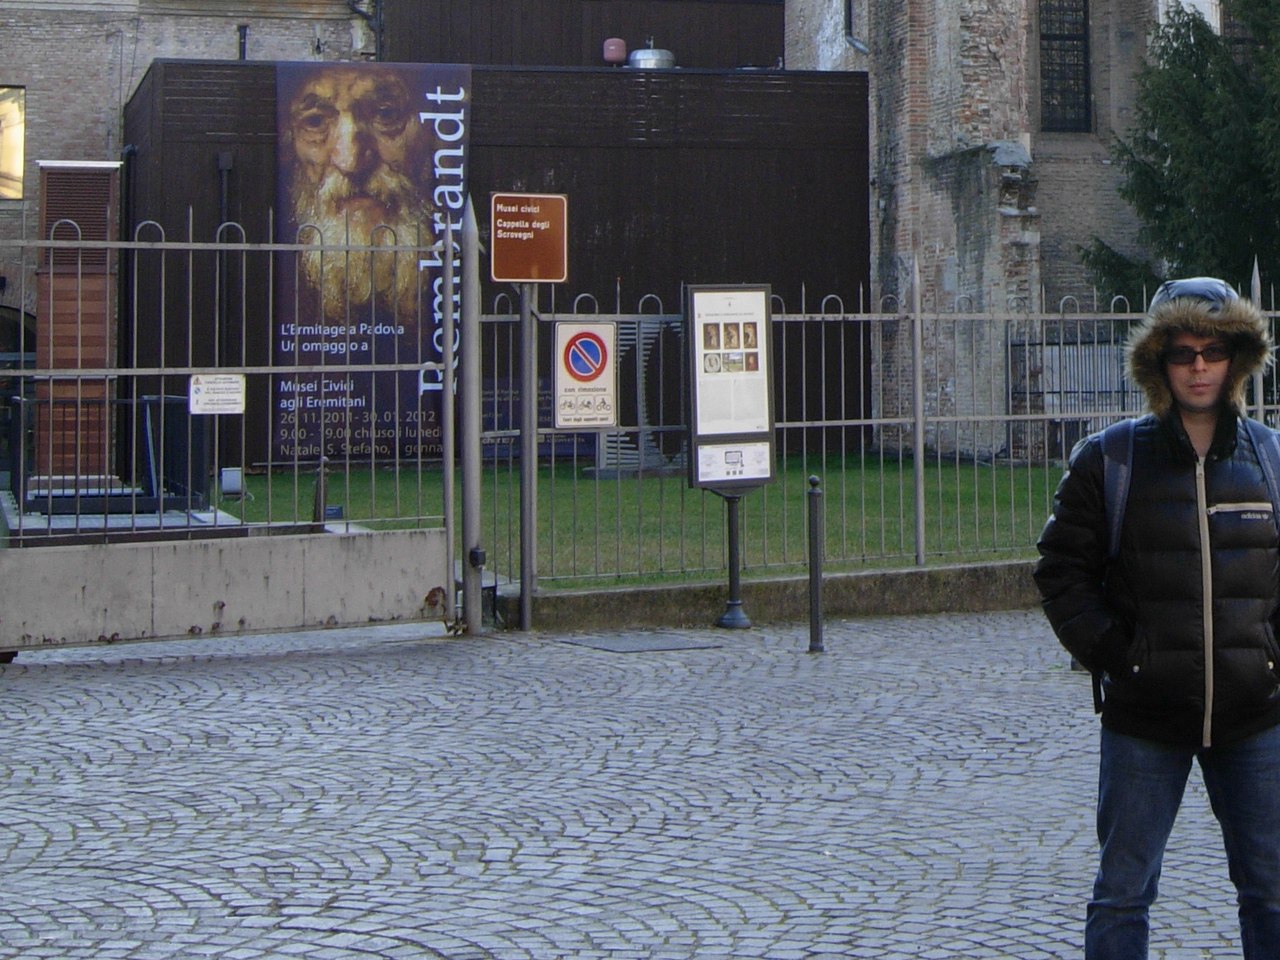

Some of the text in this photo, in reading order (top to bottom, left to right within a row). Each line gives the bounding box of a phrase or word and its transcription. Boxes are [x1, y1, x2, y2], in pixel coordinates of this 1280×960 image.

[496, 203, 540, 213] Musei civici
[496, 218, 550, 230] Cappella degli
[496, 229, 534, 241] Scrovegni
[349, 326, 356, 335] a
[360, 323, 405, 335] Padova
[302, 342, 358, 354] omaggo
[361, 343, 368, 351] a
[280, 381, 318, 392] Musei
[306, 396, 366, 408] Eremitani
[324, 411, 353, 424] 2011
[384, 411, 402, 423] 0.
[280, 428, 307, 440] 9.00
[318, 427, 352, 439] 9.00
[327, 443, 338, 455] S.
